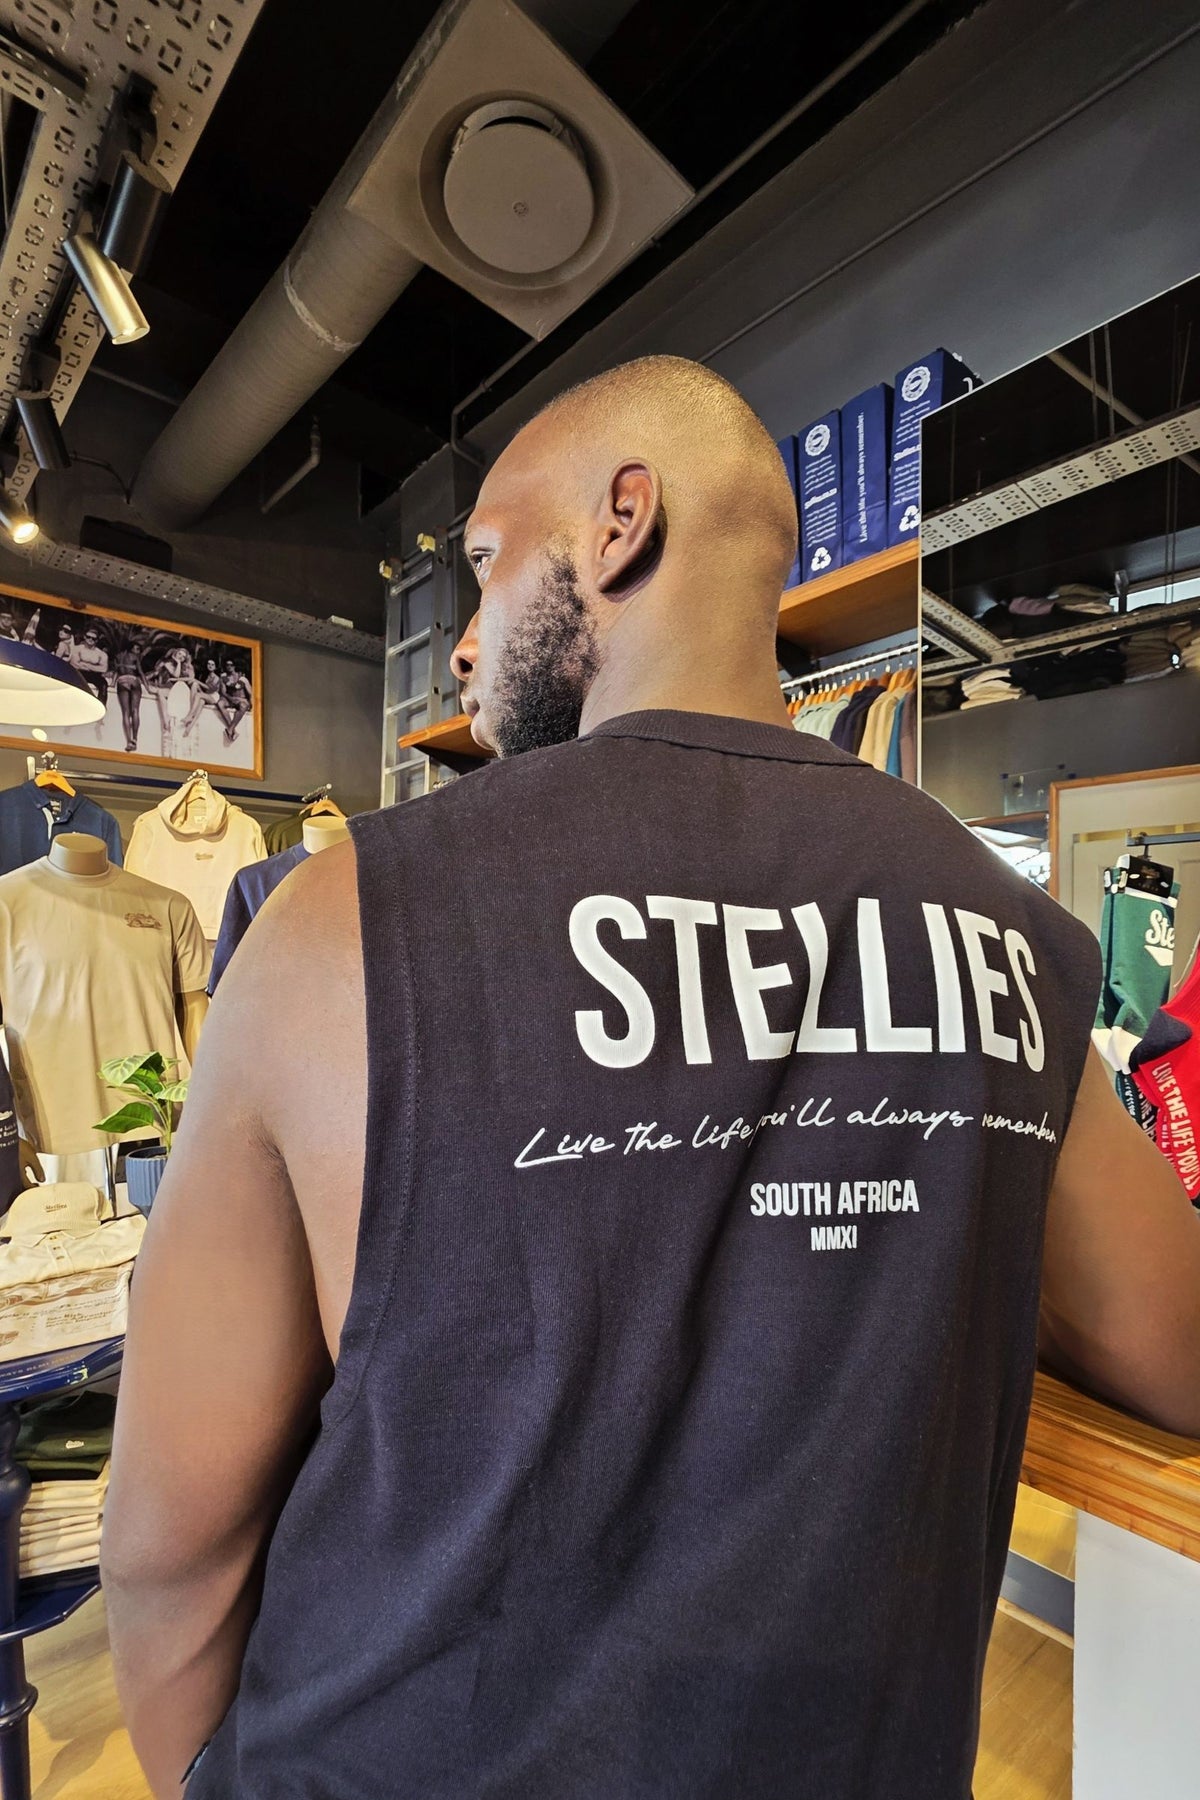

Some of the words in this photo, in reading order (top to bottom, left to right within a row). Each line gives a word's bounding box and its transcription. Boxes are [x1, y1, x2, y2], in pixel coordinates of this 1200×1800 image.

[569, 895, 1045, 1072] STELLIES
[1152, 1062, 1177, 1092] LIVE
[1163, 1086, 1189, 1120] THE
[514, 1128, 616, 1168] Live
[692, 1114, 753, 1149] life
[846, 1097, 974, 1140] always
[1170, 1118, 1195, 1148] LIFE
[750, 1182, 832, 1216] SOUTH
[837, 1179, 920, 1214] AFRICA
[810, 1225, 858, 1251] MMXI
